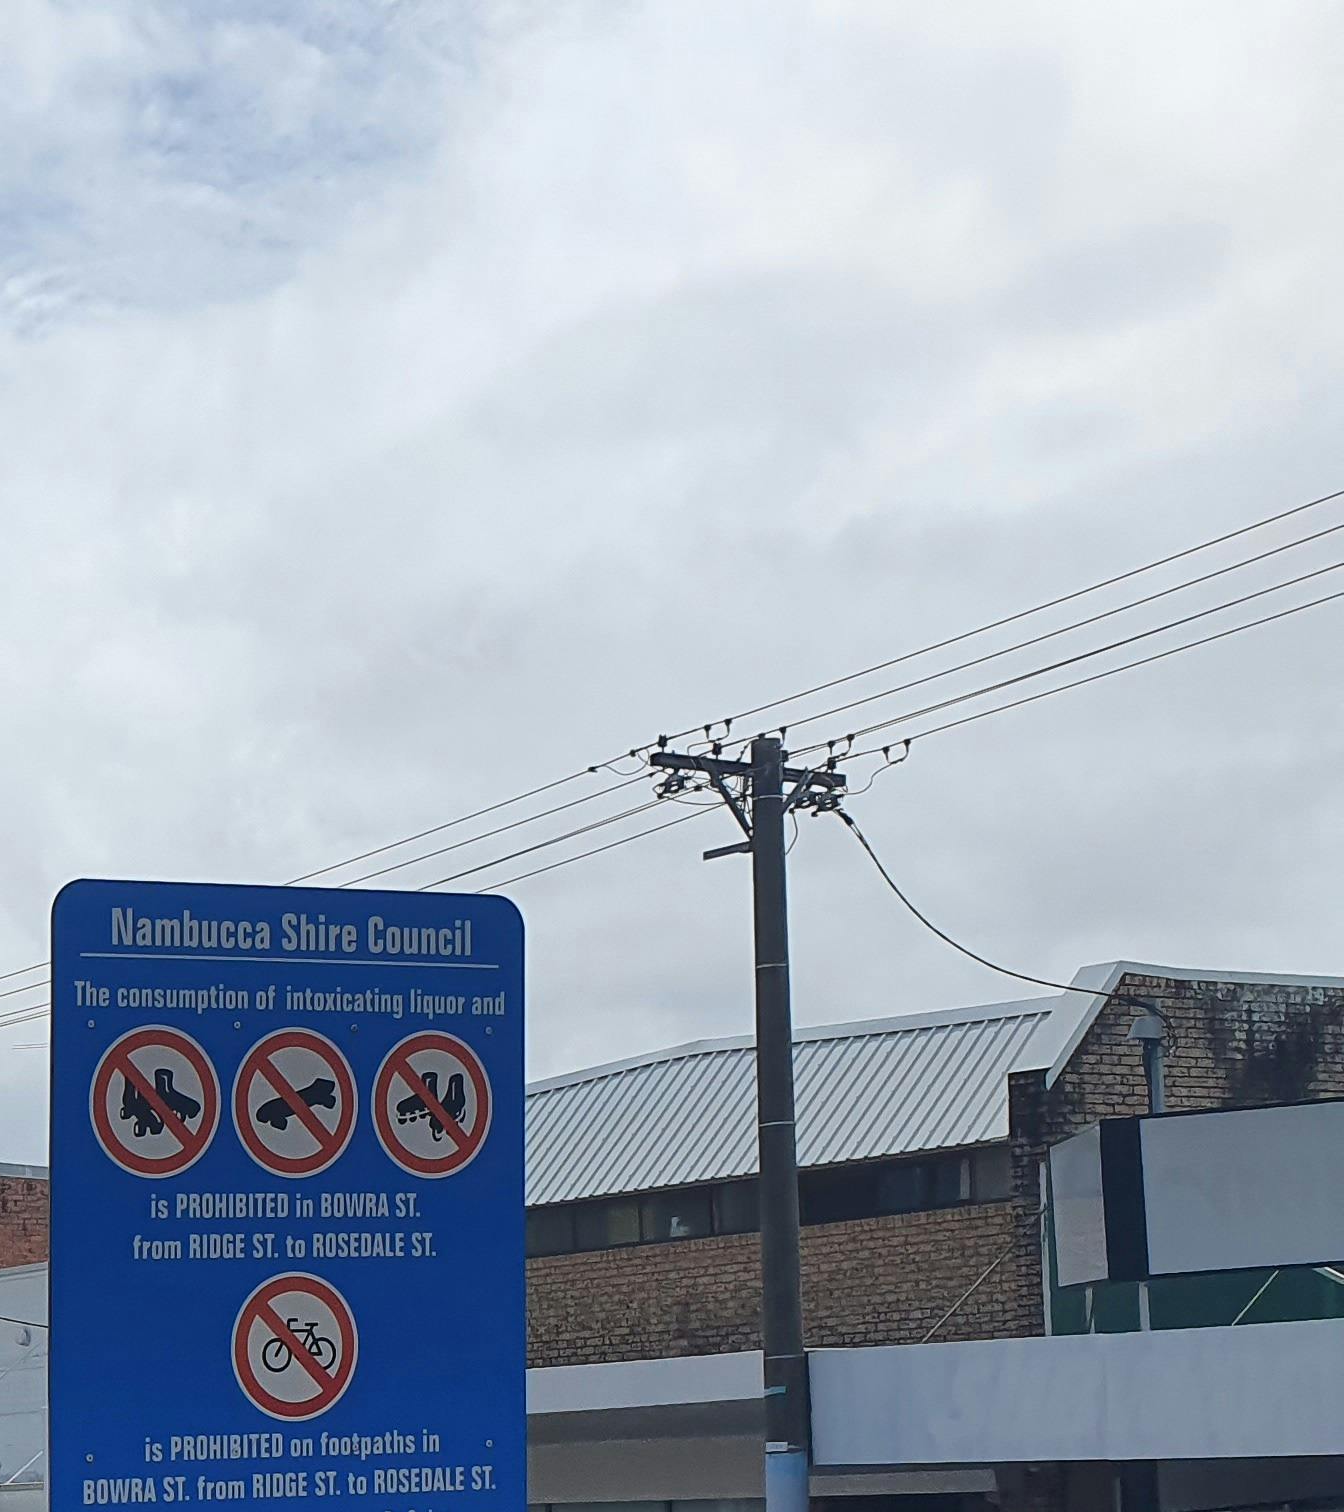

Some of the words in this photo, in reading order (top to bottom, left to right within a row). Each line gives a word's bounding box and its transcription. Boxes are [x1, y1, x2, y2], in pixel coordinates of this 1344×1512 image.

[112, 907, 270, 949] Nambucca
[281, 913, 357, 953] Shire
[368, 916, 471, 956] Council
[74, 980, 110, 1007] The
[117, 984, 249, 1013] consumption
[255, 985, 276, 1010] of
[286, 985, 403, 1018] intoxicating
[410, 989, 465, 1019] liquor
[471, 991, 505, 1015] and
[151, 1194, 168, 1219] is
[176, 1193, 289, 1219] PROHIBITED
[296, 1193, 313, 1218] in
[321, 1192, 389, 1218] BOWRA
[395, 1192, 421, 1218] ST.
[133, 1235, 182, 1260] from
[189, 1233, 245, 1259] RIDGE
[252, 1233, 279, 1259] ST.
[286, 1235, 306, 1258] to
[312, 1232, 405, 1258] ROSEDALE
[411, 1232, 436, 1257] ST.
[145, 1437, 163, 1462] is
[170, 1433, 283, 1461] PROHIBITED
[290, 1438, 313, 1457] on
[320, 1430, 416, 1461] footpaths
[422, 1429, 440, 1453] in
[83, 1477, 157, 1505] BOWRA
[163, 1476, 190, 1502] ST.
[197, 1476, 245, 1500] from
[252, 1472, 307, 1498] RIDGE
[315, 1471, 341, 1497] ST.
[347, 1472, 367, 1495] to
[374, 1467, 465, 1494] ROSEDALE
[471, 1465, 496, 1490] ST.
